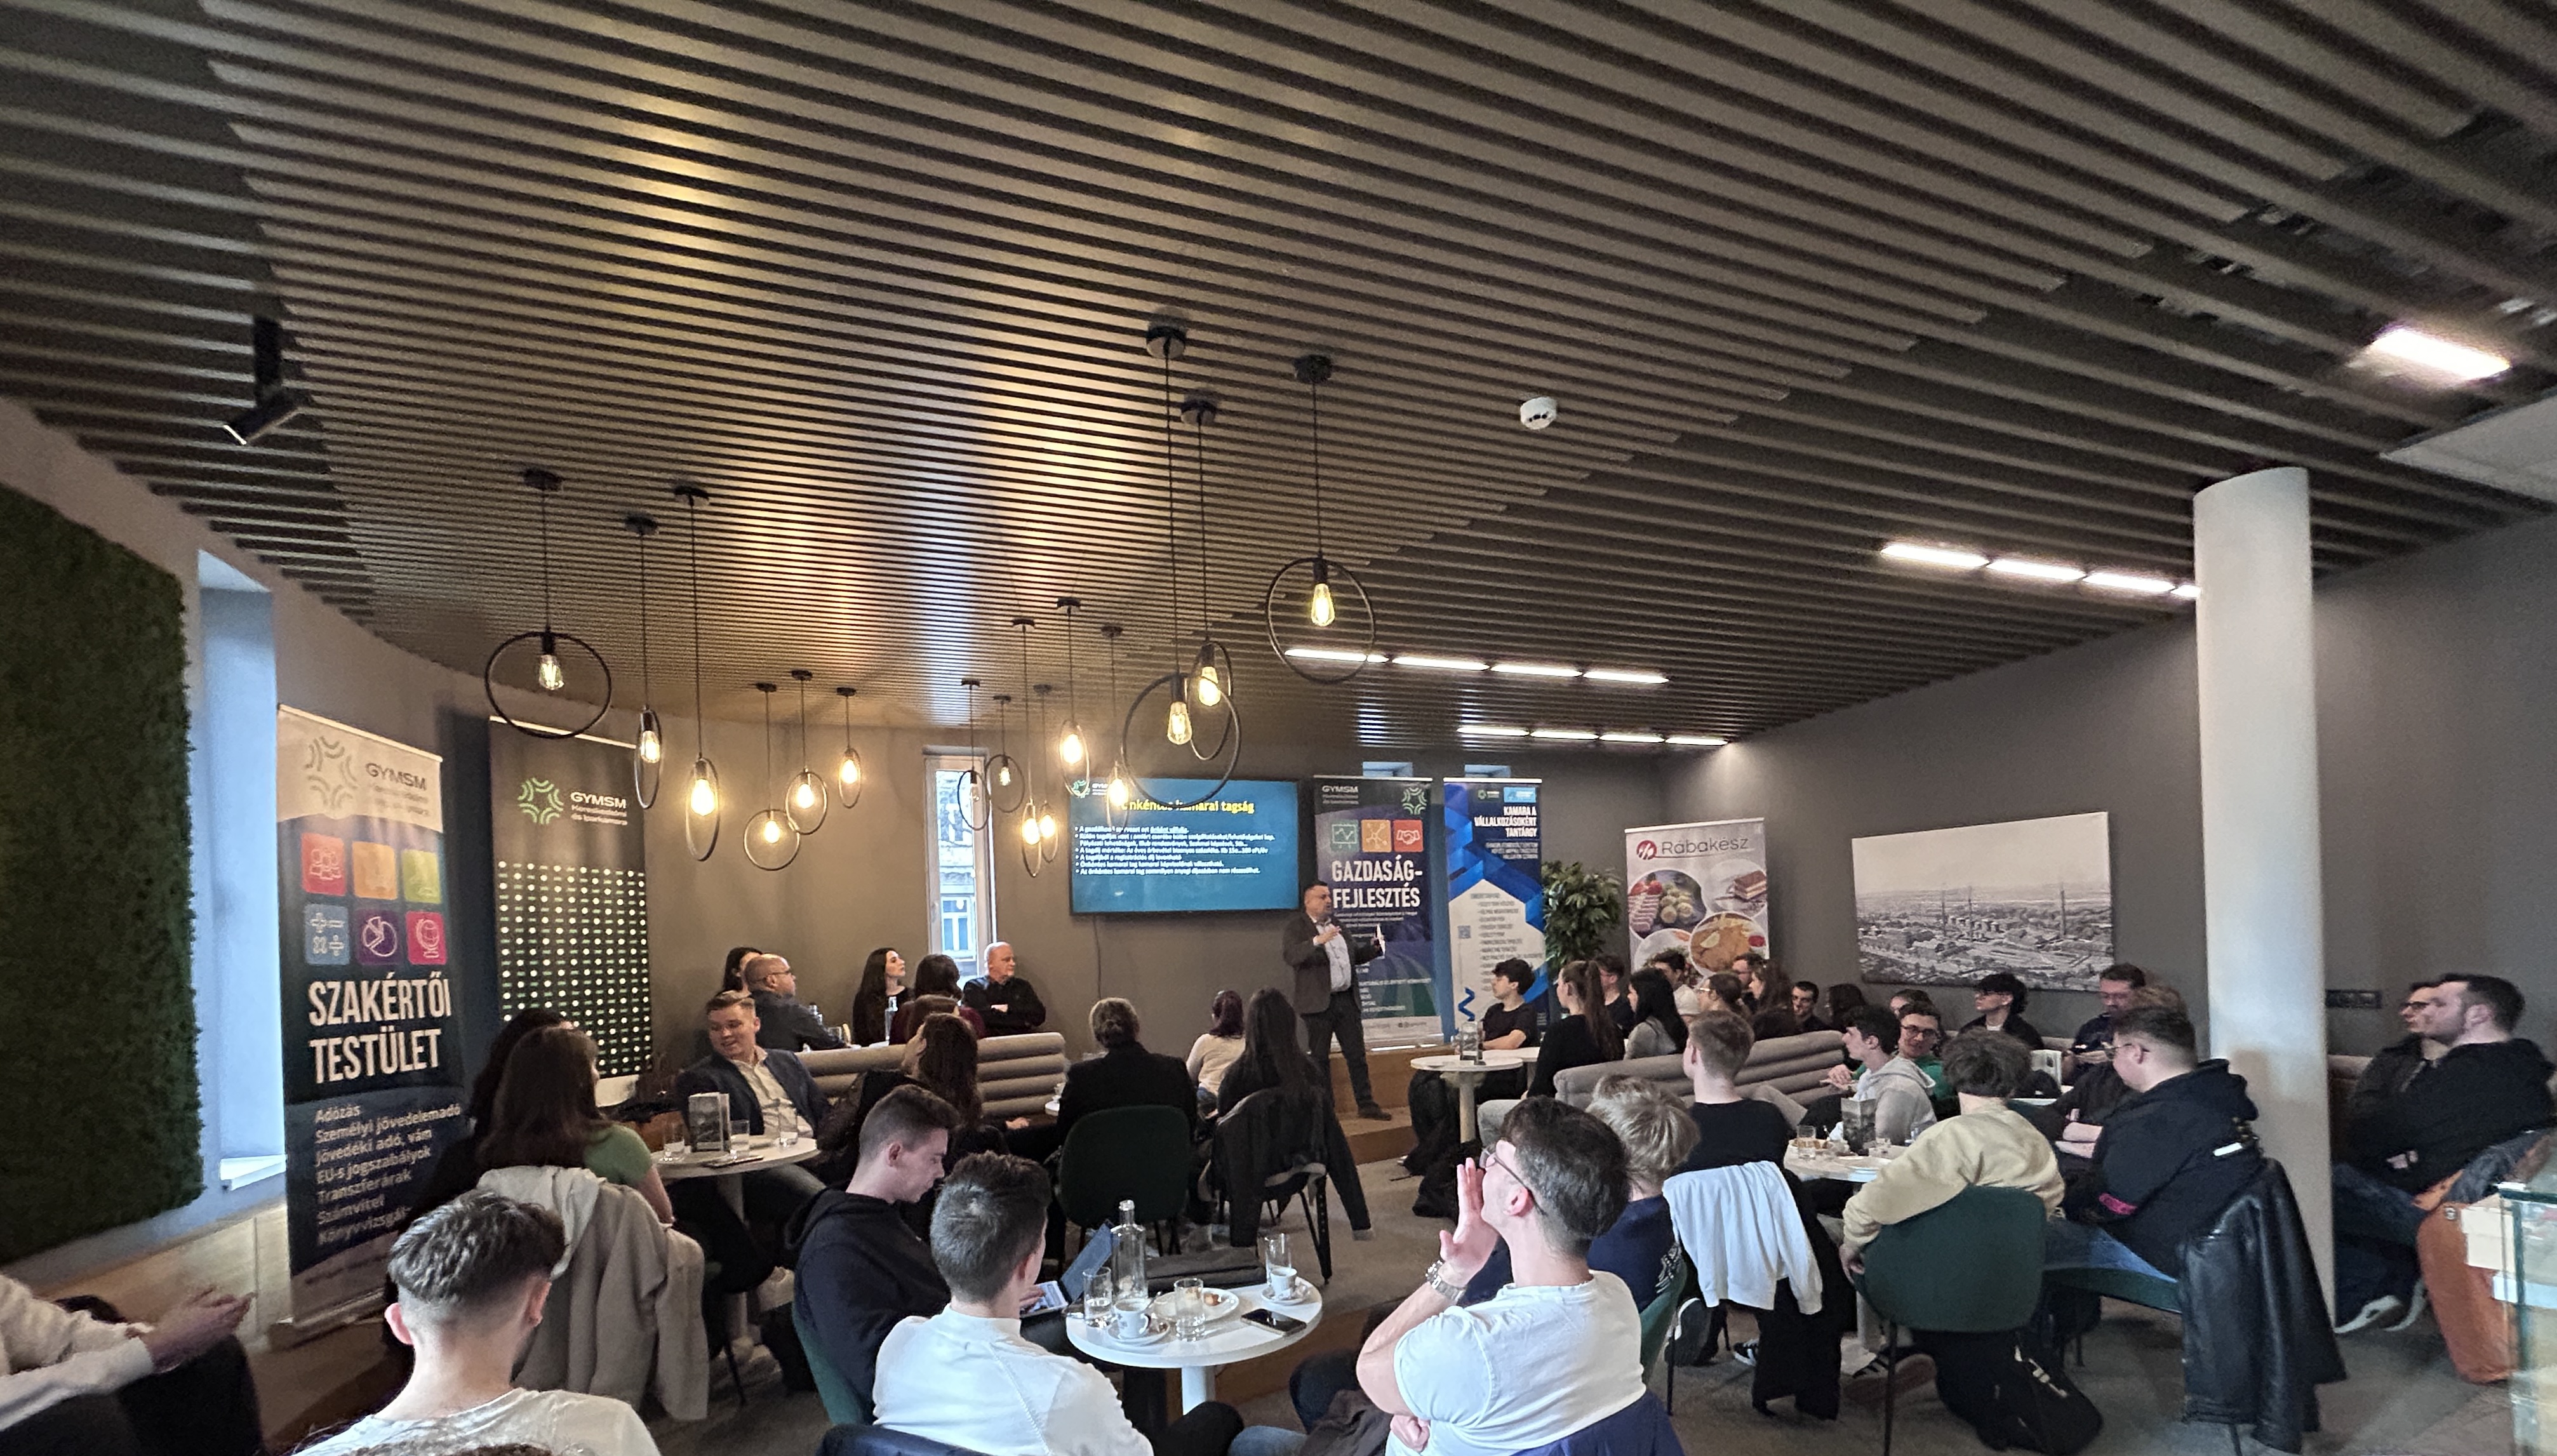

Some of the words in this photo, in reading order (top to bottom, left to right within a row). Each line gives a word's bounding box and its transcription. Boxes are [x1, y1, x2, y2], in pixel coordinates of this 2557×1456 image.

[366, 763, 427, 791] GYMSM
[1321, 785, 1359, 793] GYMSM
[570, 791, 626, 809] GYMSM
[1221, 800, 1255, 813] tagság
[1504, 806, 1531, 816] KAMARA
[1532, 806, 1537, 816] A
[1474, 815, 1537, 827] VÁLLALKOZÁSOKÉRT
[1505, 826, 1538, 838] TANTÁRGY
[1331, 854, 1423, 882] GAZDASÁG-
[1332, 882, 1420, 909] FEJLESZTÉS
[308, 971, 451, 1026] SZAKÉRTŐI
[309, 1025, 441, 1083] TESTÜLET
[315, 1104, 361, 1123] Adózás
[316, 1119, 374, 1143] Személyi
[375, 1103, 461, 1135] jövedelemadó
[376, 1133, 405, 1151] adó,
[407, 1128, 432, 1143] vám
[347, 1145, 431, 1180] jogszabályok
[318, 1169, 411, 1204] Transzferárak
[318, 1193, 384, 1225] Számvitel
